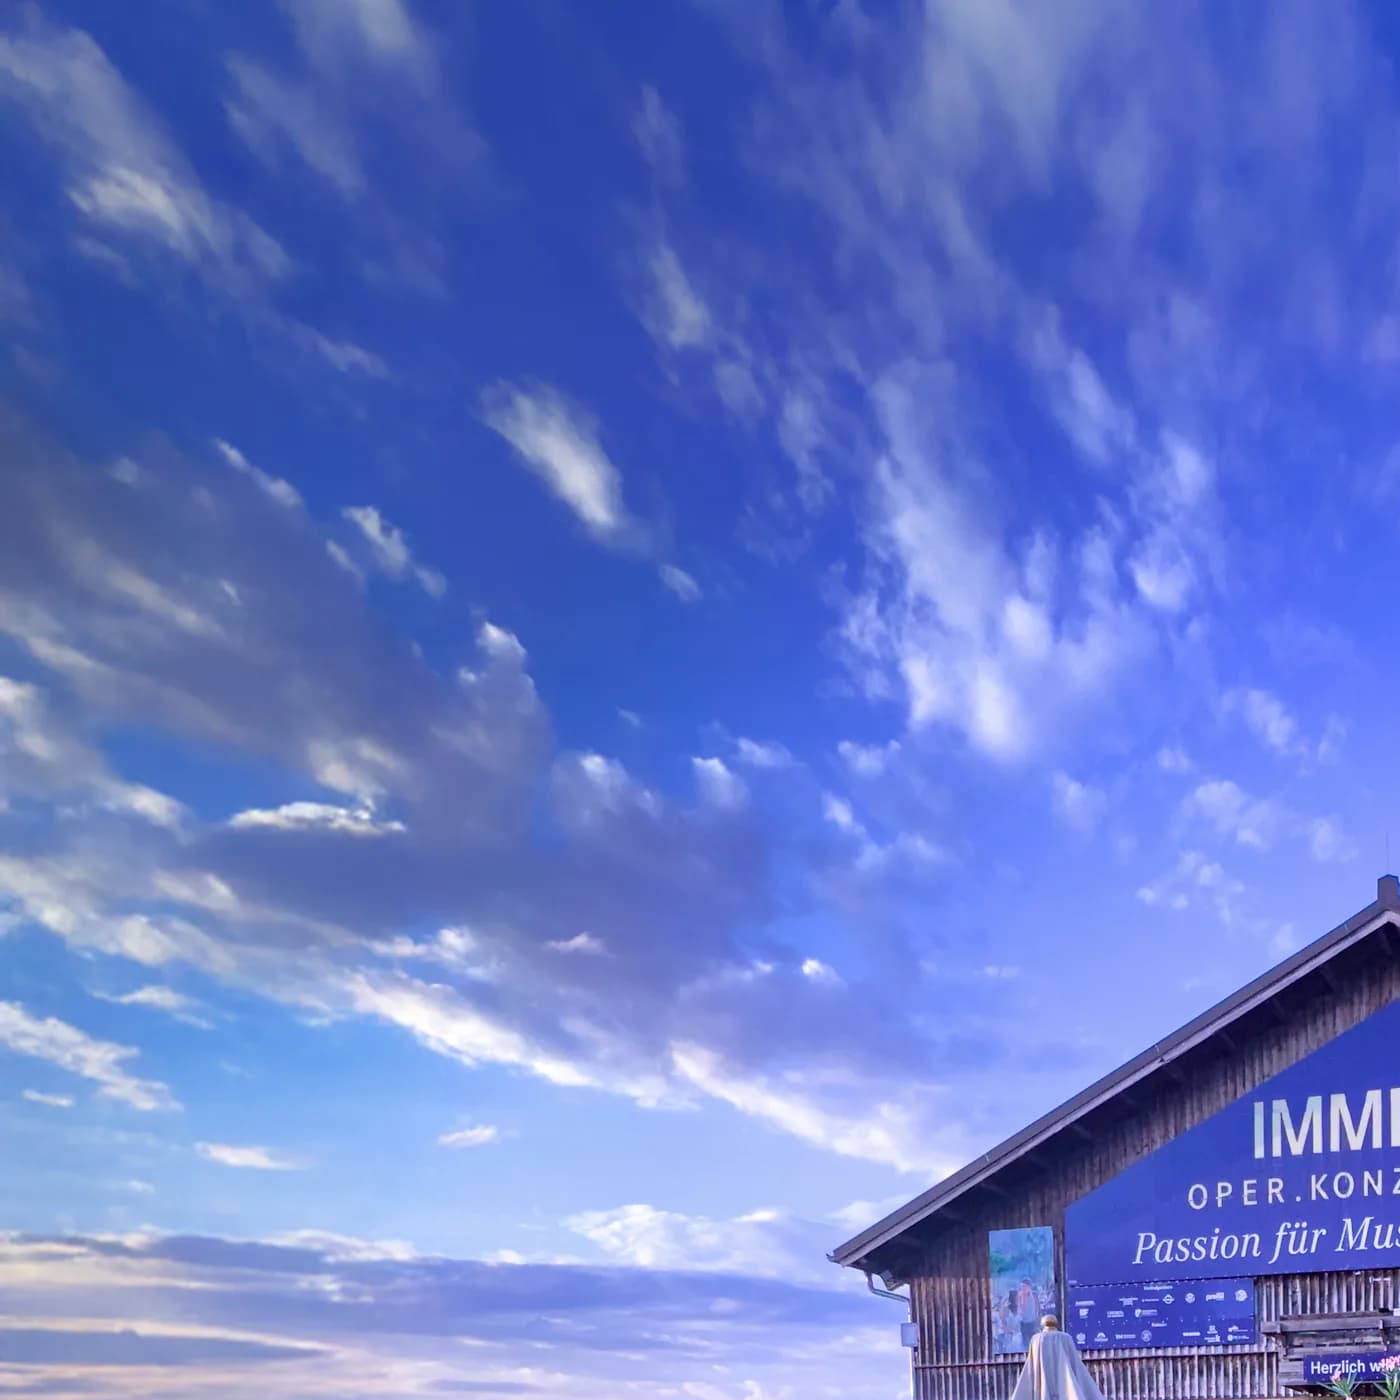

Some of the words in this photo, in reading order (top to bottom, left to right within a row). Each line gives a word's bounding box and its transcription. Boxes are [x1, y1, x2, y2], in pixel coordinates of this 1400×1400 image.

[1132, 1228, 1261, 1265] Passion
[1268, 1221, 1327, 1265] für
[1311, 1359, 1365, 1374] Herzlich
